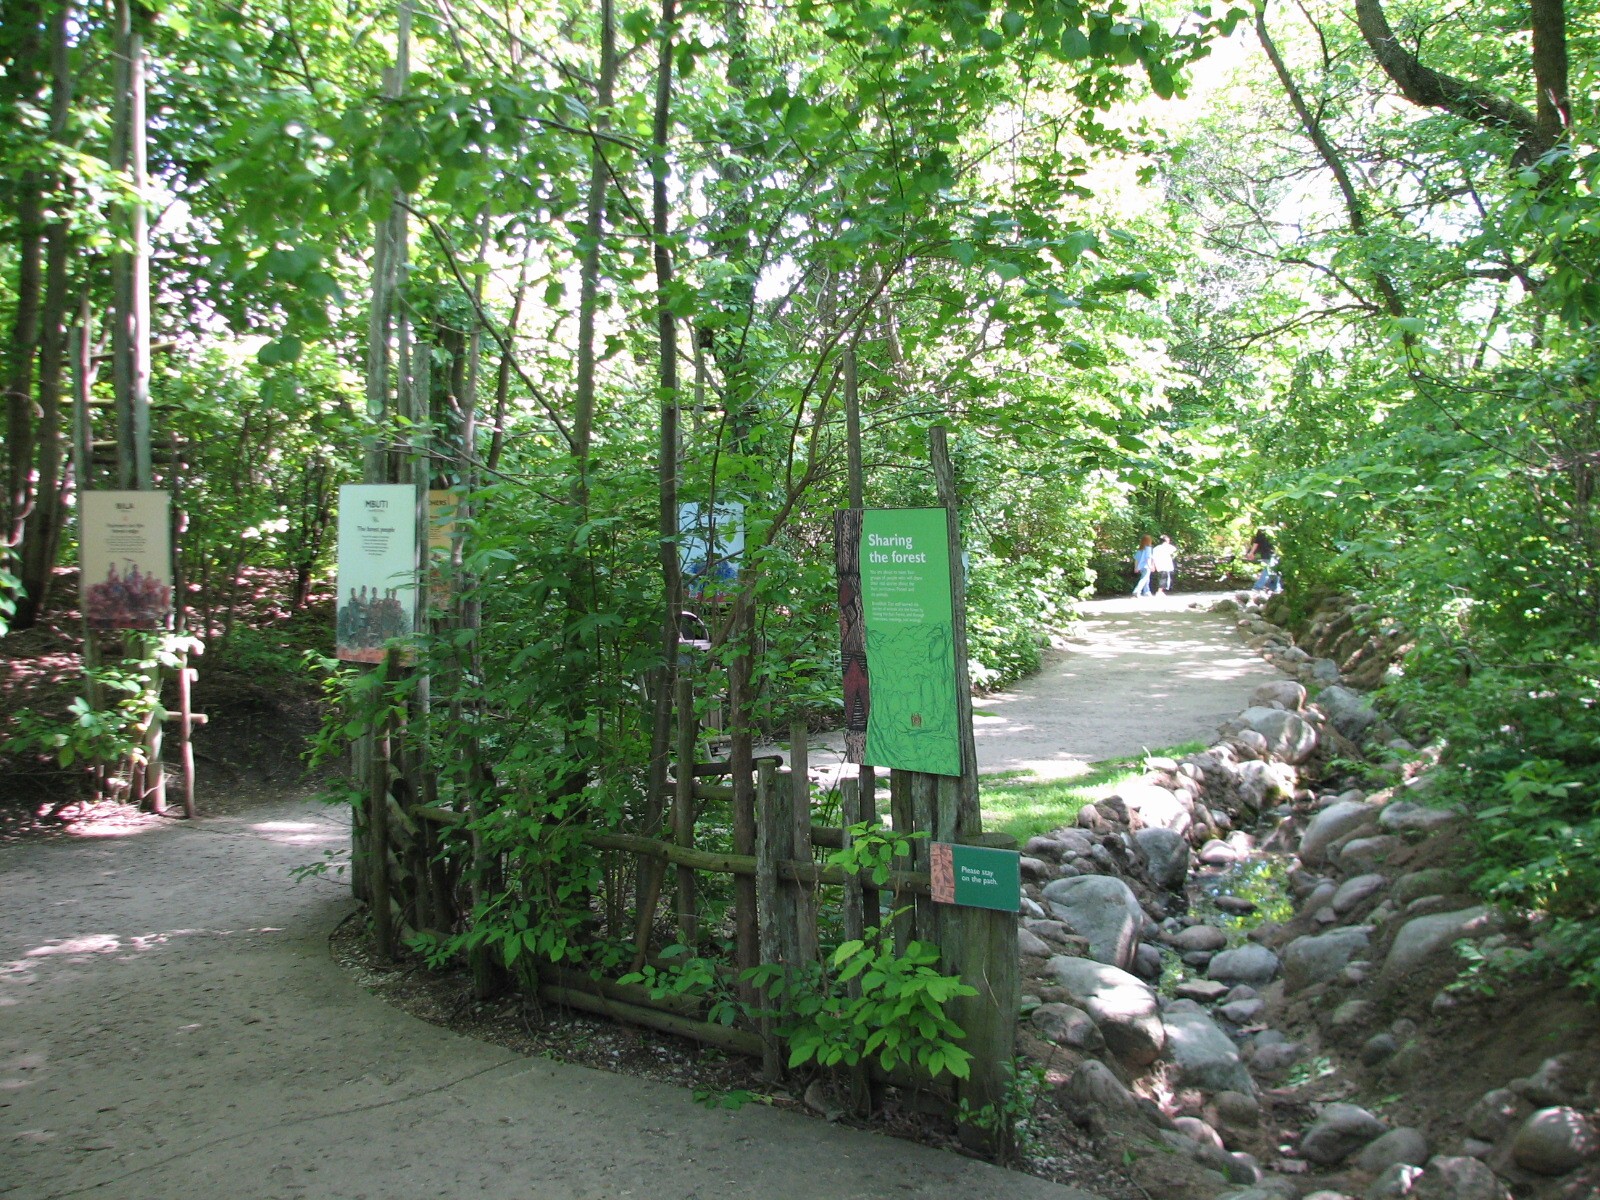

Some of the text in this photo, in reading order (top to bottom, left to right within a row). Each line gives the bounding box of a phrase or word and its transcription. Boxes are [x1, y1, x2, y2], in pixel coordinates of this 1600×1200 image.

[365, 500, 388, 508] MBUTI
[380, 526, 395, 534] people
[868, 534, 912, 549] Sharing
[869, 551, 926, 563] the forest
[961, 866, 993, 877] Please stay
[983, 877, 998, 885] path.
